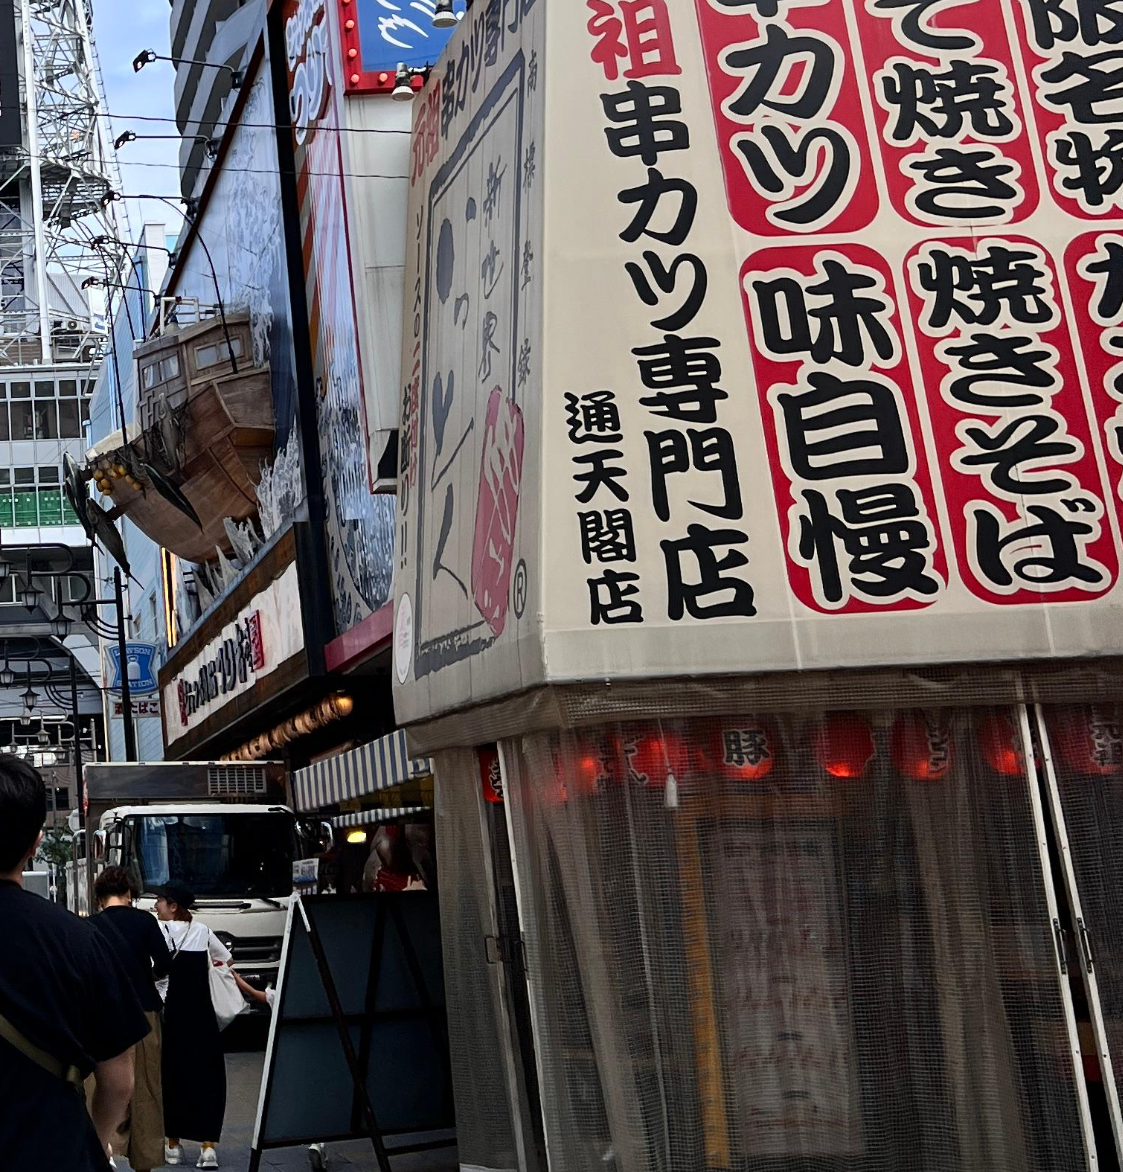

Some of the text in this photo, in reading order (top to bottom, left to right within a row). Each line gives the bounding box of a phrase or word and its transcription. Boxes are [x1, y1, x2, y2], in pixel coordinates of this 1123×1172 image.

[753, 260, 939, 603] 味自慢
[919, 243, 1104, 586] 焼きそば
[564, 390, 645, 625] 通天閣店
[114, 647, 151, 657] LWSON
[115, 678, 153, 688] SATION
[723, 728, 772, 768] 豚
